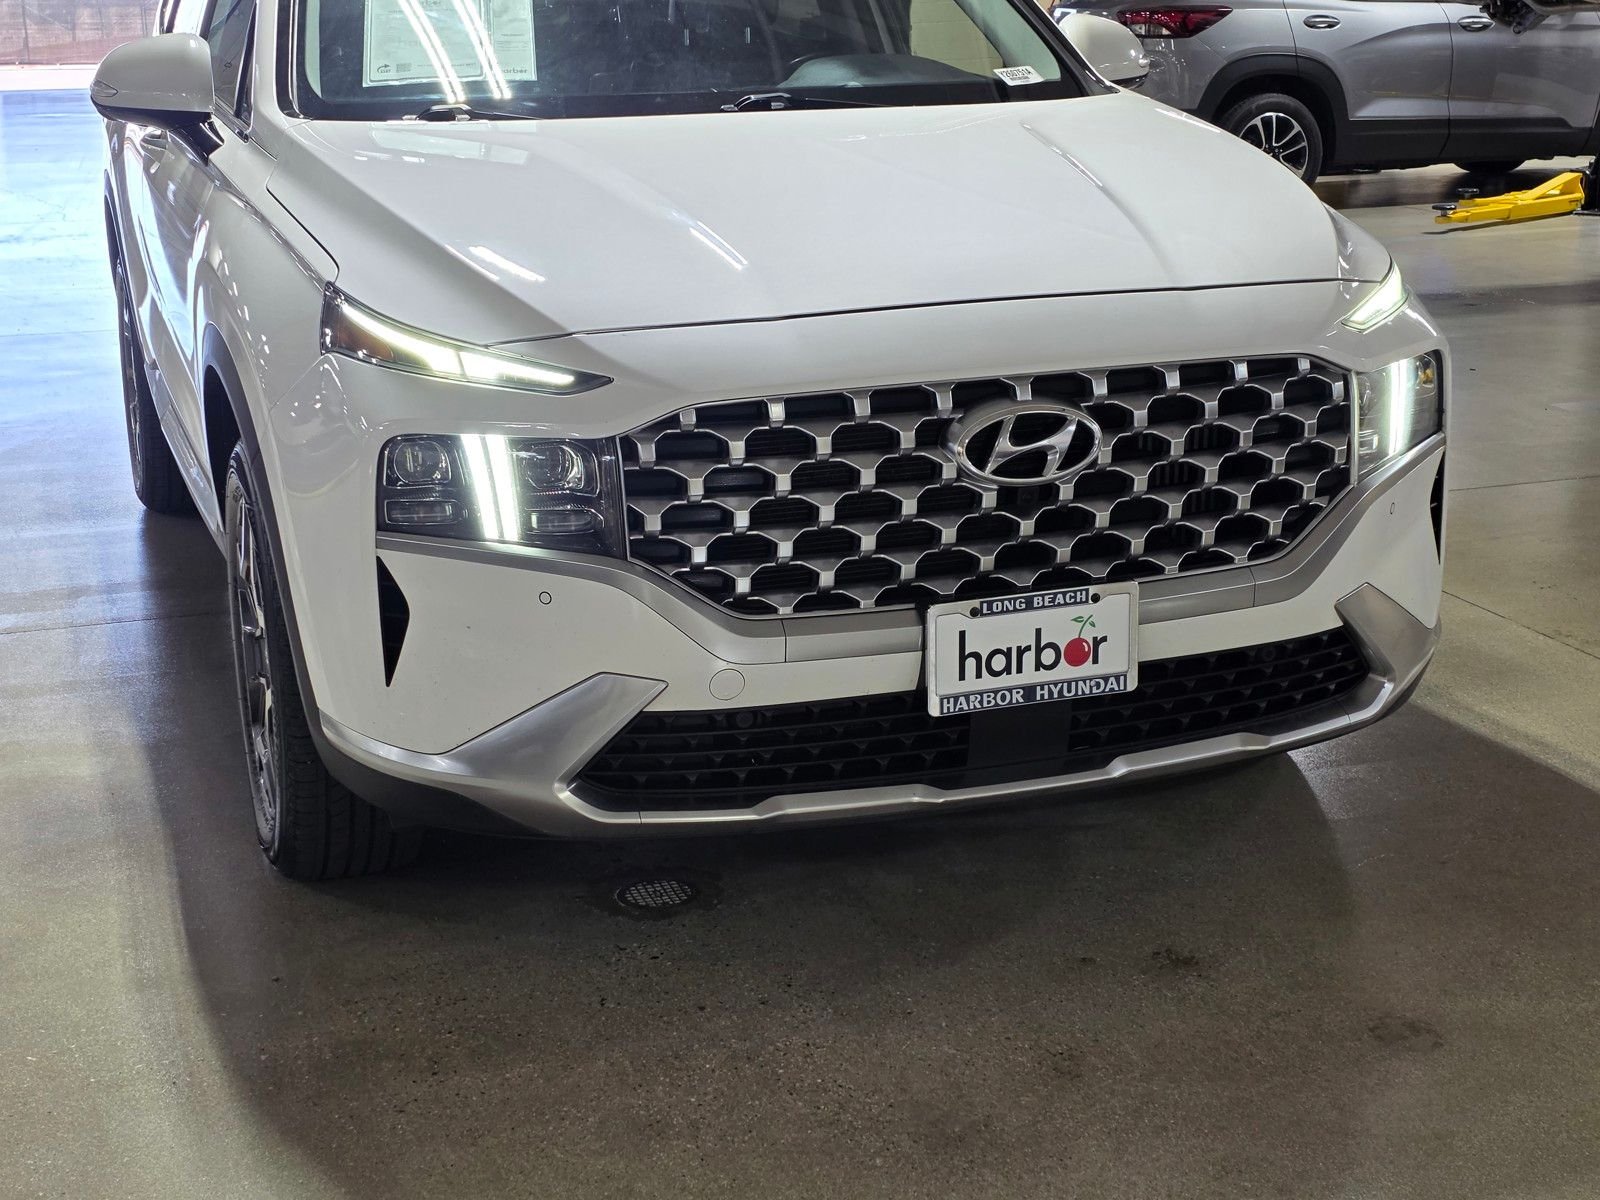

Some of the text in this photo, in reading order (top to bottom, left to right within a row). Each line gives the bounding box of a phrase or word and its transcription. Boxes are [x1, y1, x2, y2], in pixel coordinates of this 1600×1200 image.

[982, 590, 1087, 615] LONG BEACH
[958, 627, 1108, 682] harbor
[943, 675, 1125, 713] HARBOR HYUNDAI
